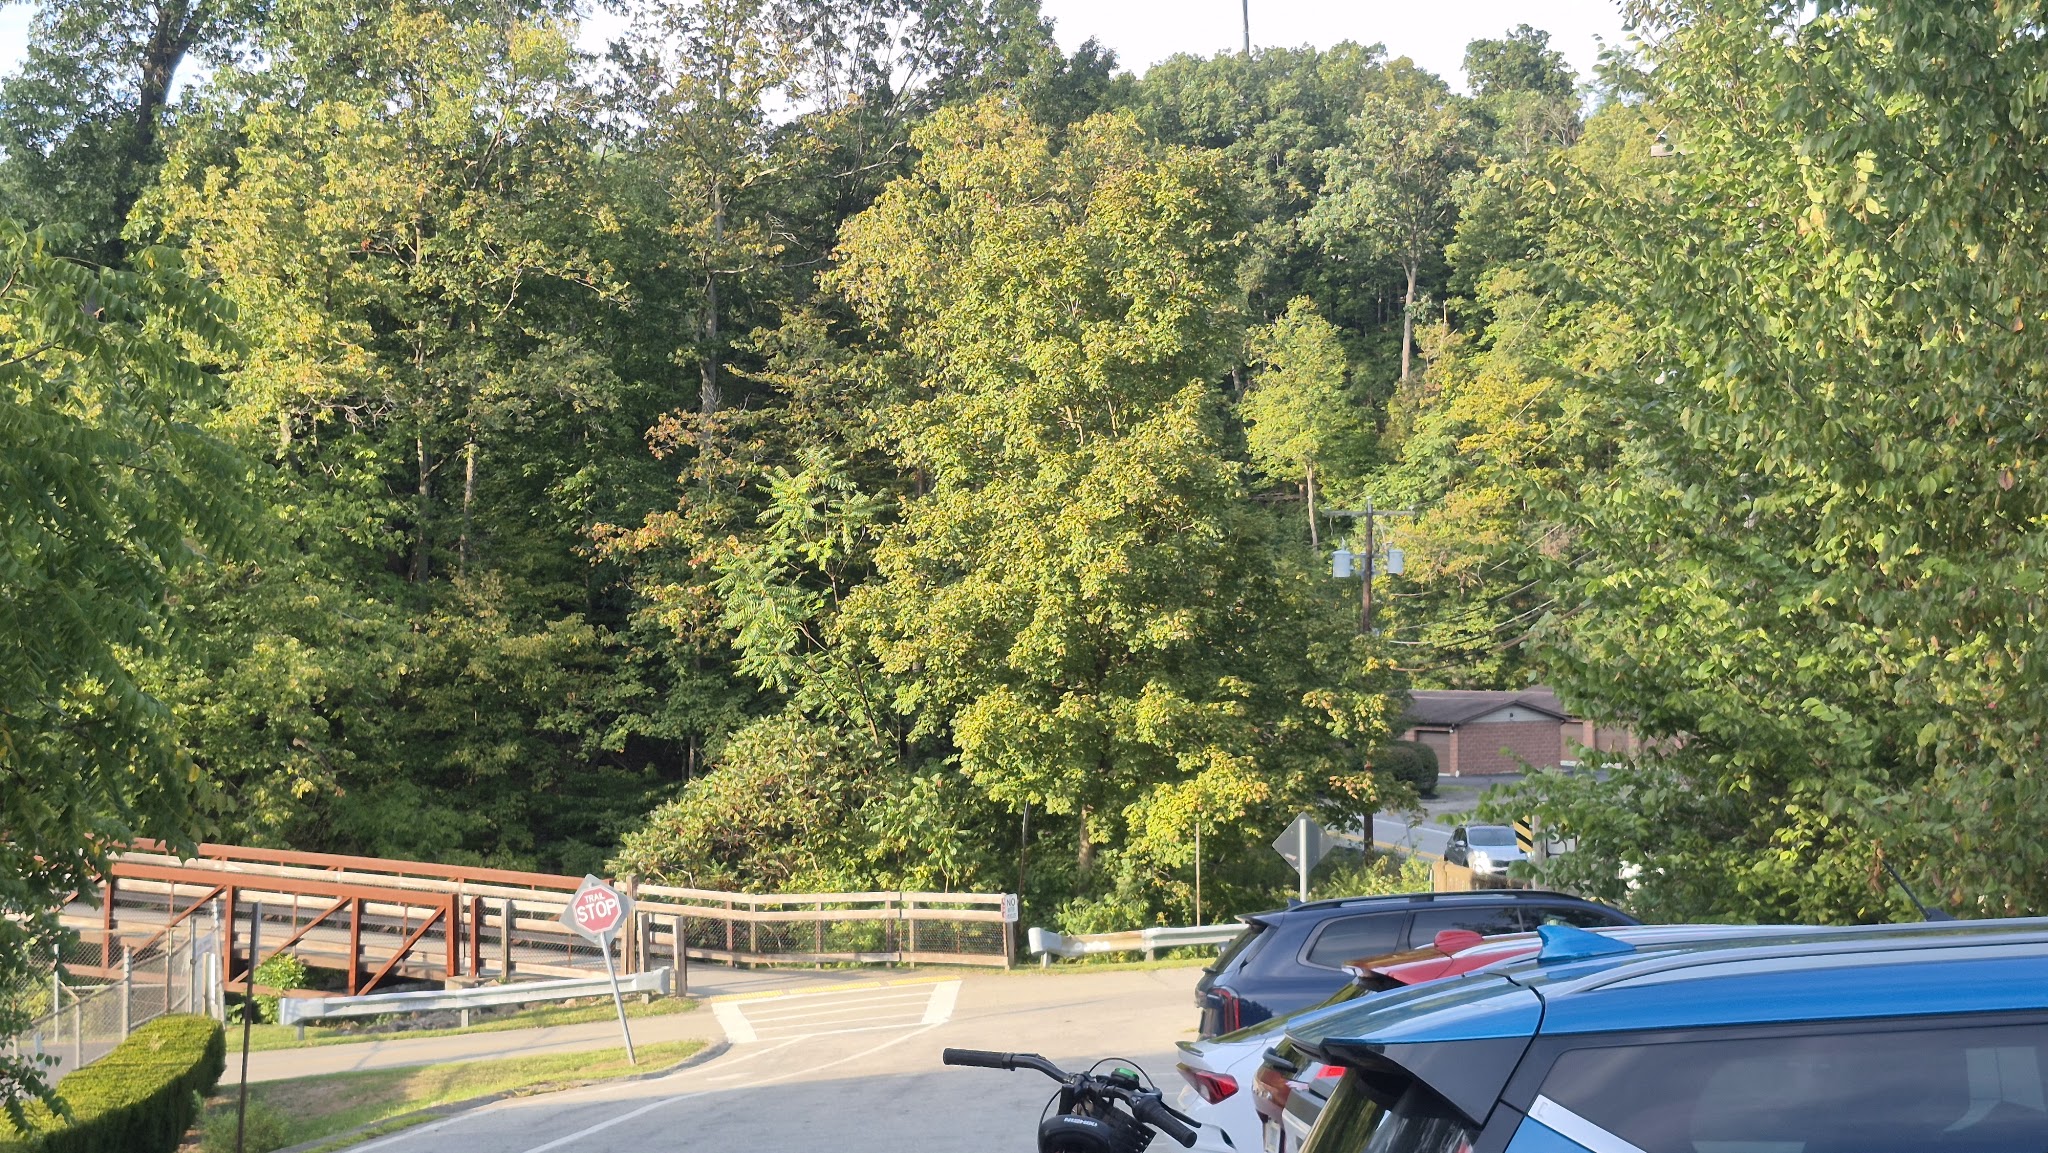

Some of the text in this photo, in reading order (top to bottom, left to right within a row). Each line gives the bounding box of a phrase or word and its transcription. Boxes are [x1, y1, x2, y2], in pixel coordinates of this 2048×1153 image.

[584, 892, 606, 903] TRAIL
[1006, 898, 1016, 907] NO
[576, 898, 616, 923] STOP
